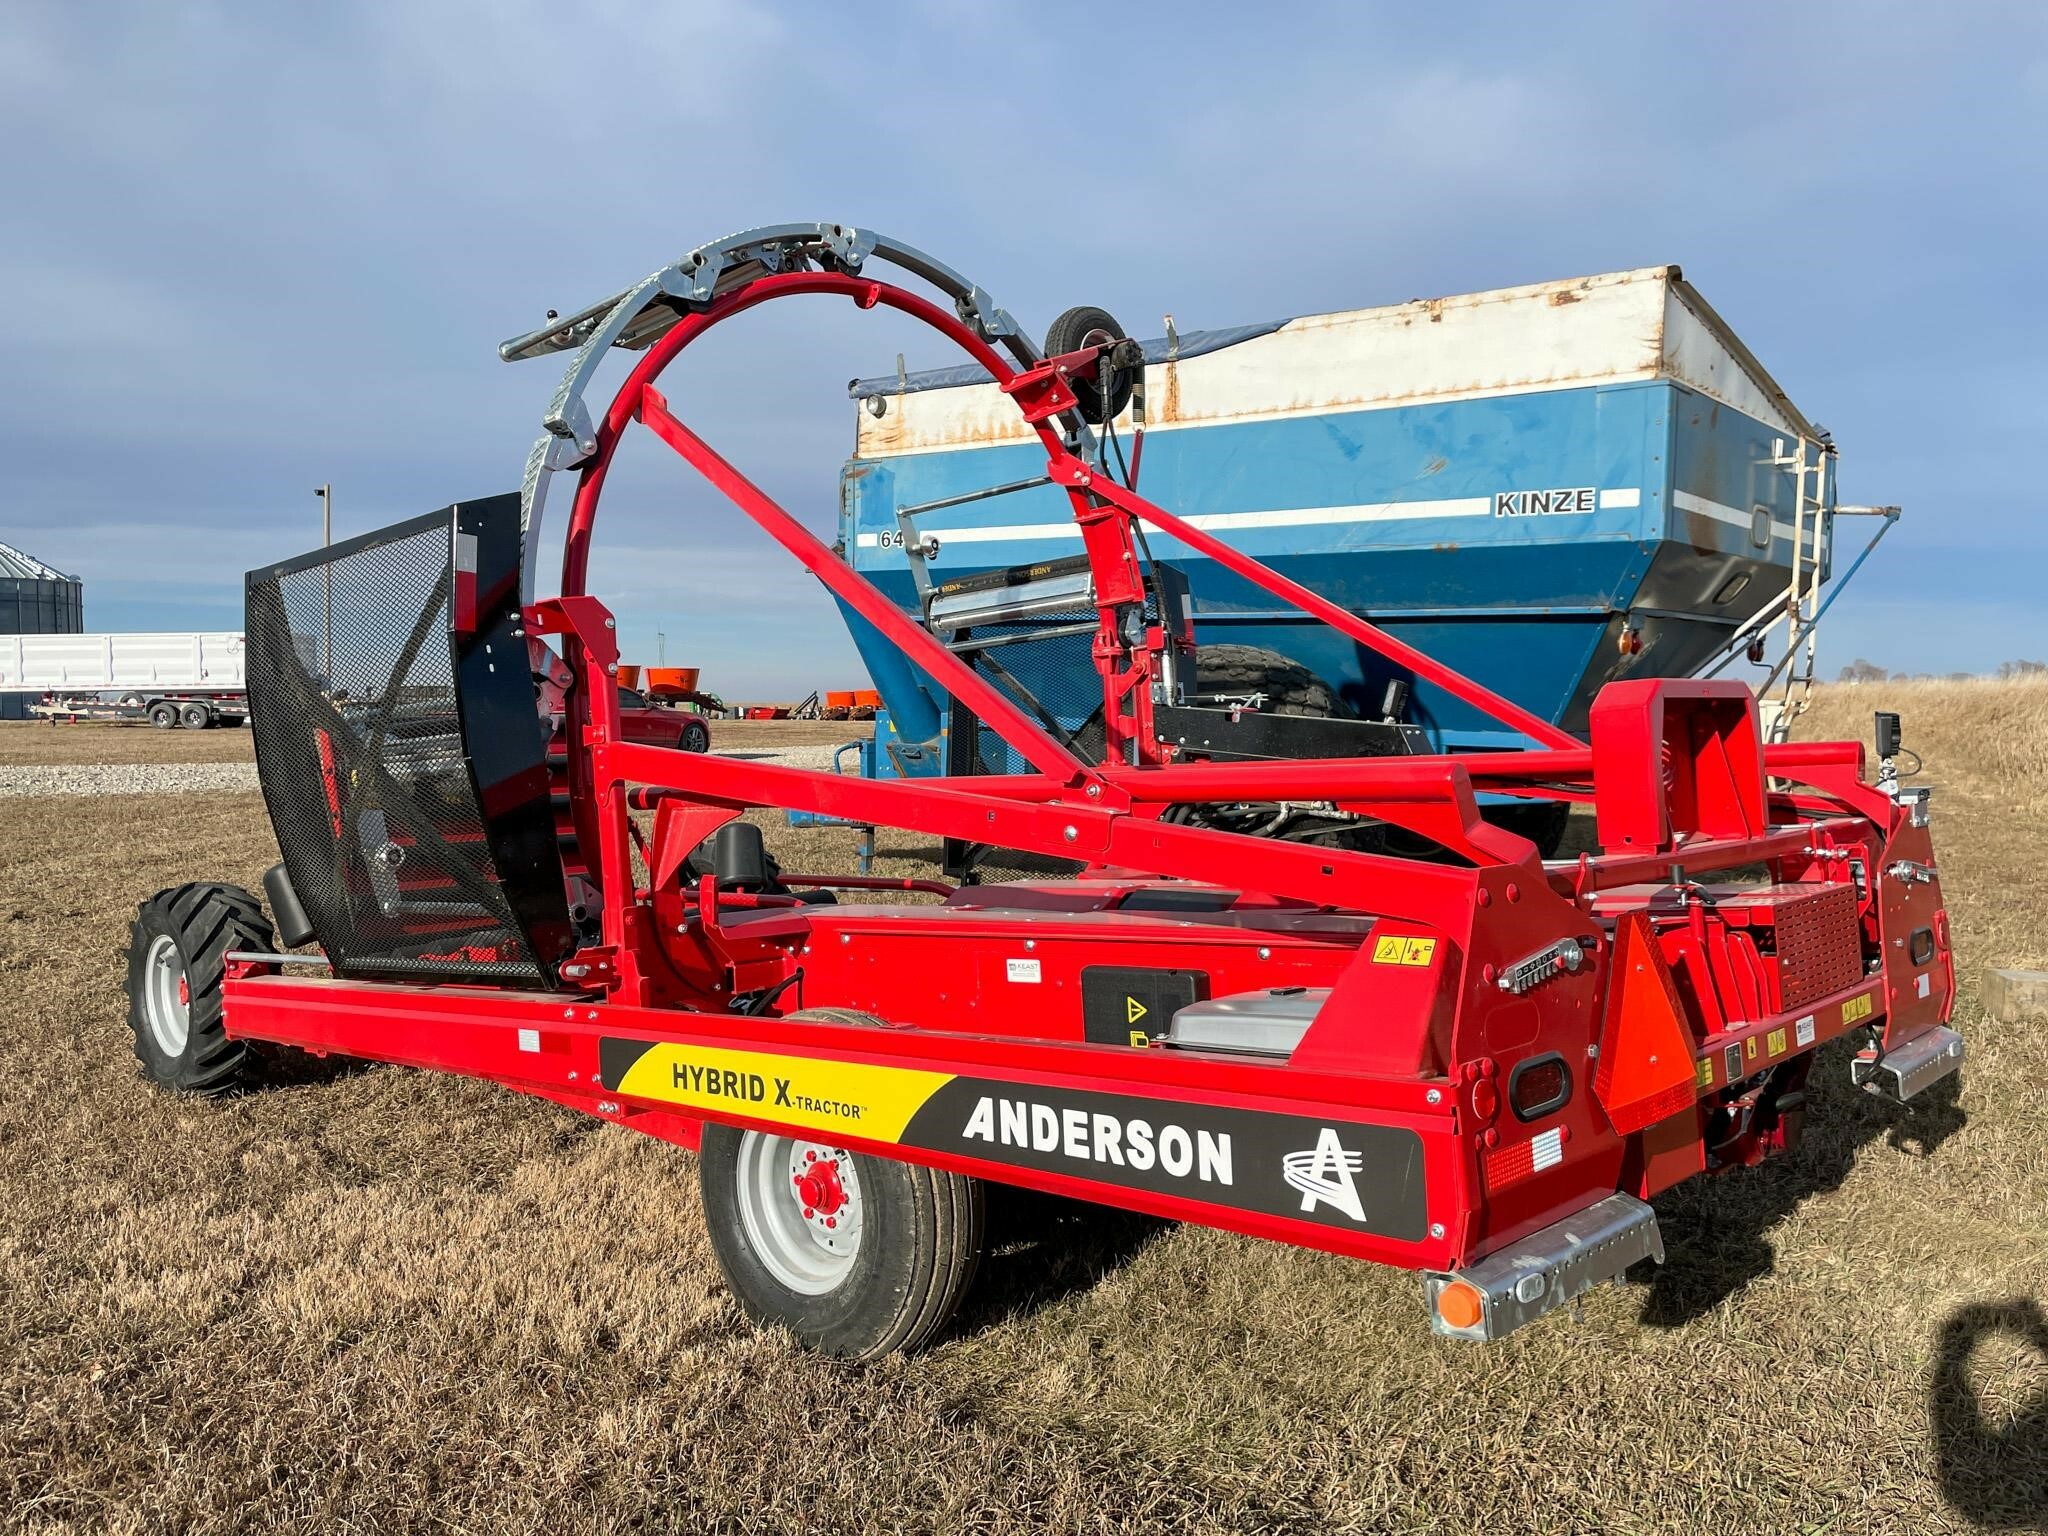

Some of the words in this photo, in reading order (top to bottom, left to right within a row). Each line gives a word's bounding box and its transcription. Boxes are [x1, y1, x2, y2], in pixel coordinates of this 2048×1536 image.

[1496, 488, 1595, 517] KINZE
[672, 1062, 765, 1102] HYBRID
[962, 1096, 1234, 1186] ANDERSON
